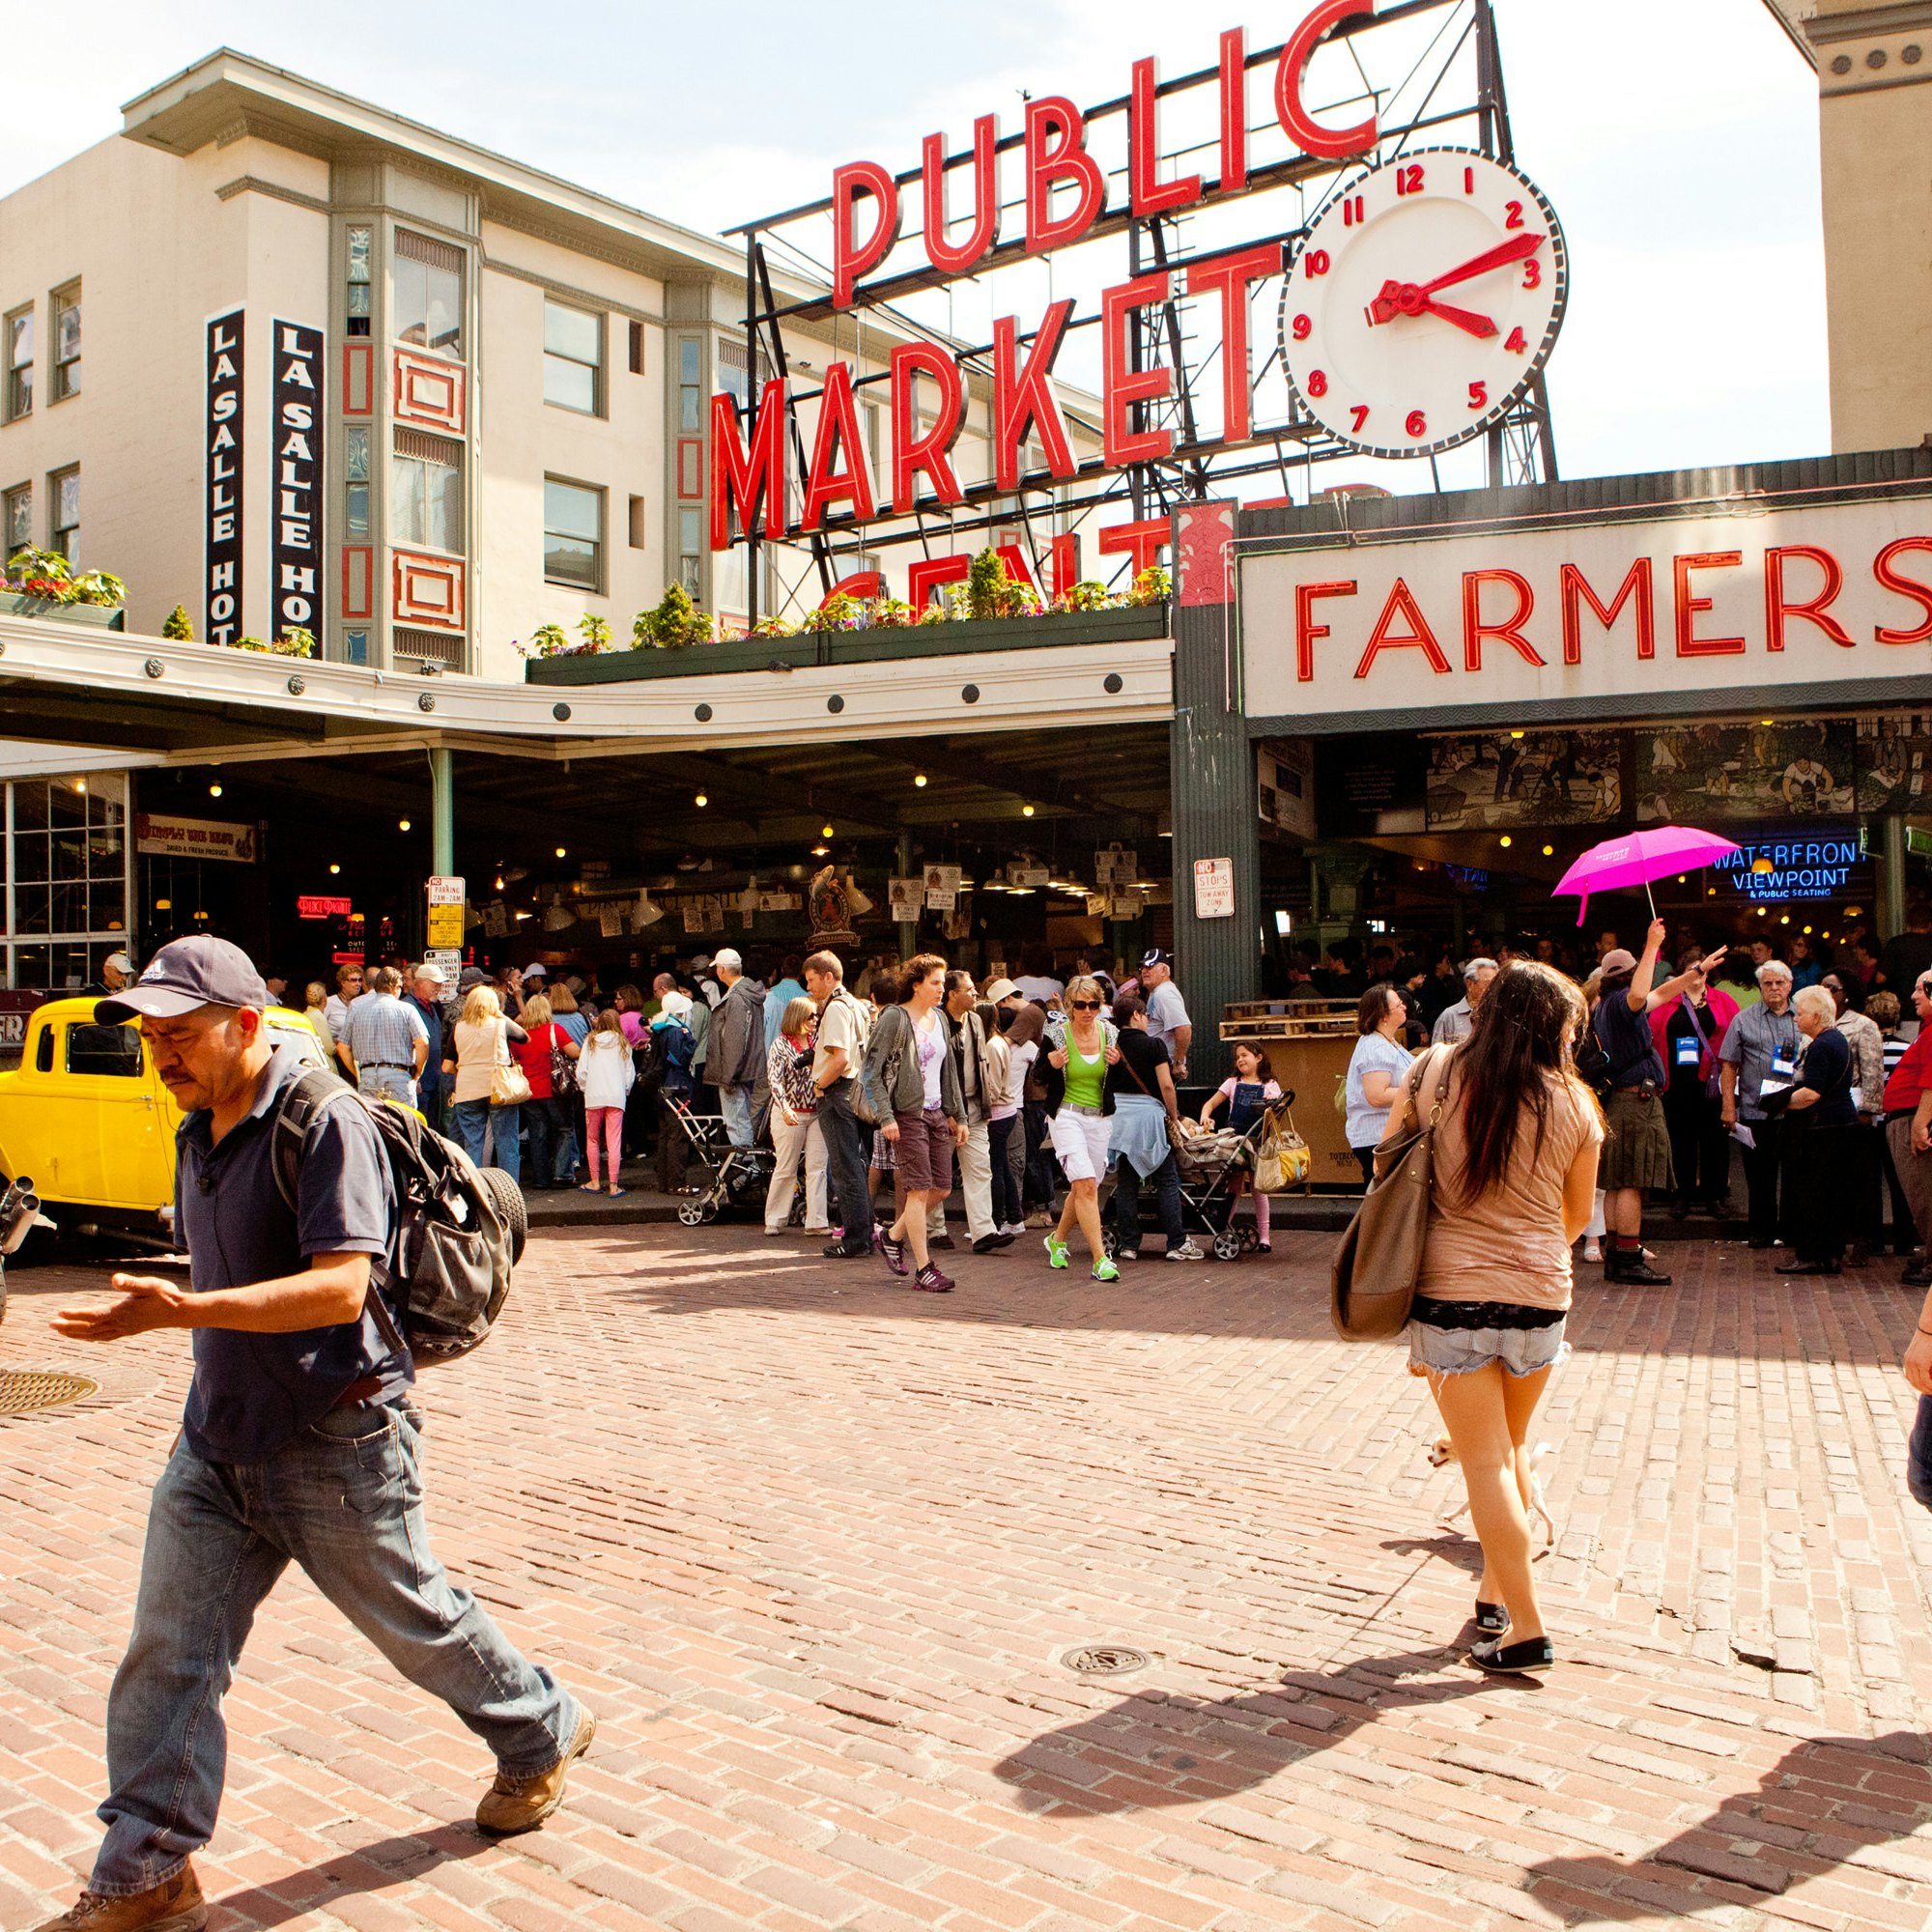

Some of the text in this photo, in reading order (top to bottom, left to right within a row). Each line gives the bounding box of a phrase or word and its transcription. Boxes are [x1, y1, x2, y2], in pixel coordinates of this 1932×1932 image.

[833, 0, 1379, 309] PUBLIC
[1396, 164, 1425, 197] 12
[1463, 166, 1474, 195] 1
[1343, 196, 1365, 227] 11
[1504, 200, 1525, 231] 2
[1304, 249, 1331, 280] 10
[1521, 259, 1543, 290] 3
[1292, 313, 1313, 341] 9
[1503, 326, 1528, 355] 4
[213, 326, 238, 382] LA
[711, 242, 1285, 551] MARKET
[1306, 369, 1328, 398] 8
[1467, 381, 1489, 411] 5
[1350, 405, 1370, 433] 7
[1405, 410, 1427, 438] 6
[212, 391, 238, 544] SALLE
[280, 327, 315, 641] LA SALLE HO
[1294, 535, 1932, 682] FARMERS
[1198, 862, 1212, 874] NO
[1714, 842, 1866, 869] WATERFRON
[1199, 874, 1228, 887] STOPS
[1733, 867, 1850, 890] VIEWPOINT
[1749, 888, 1832, 898] & PUBLIC SEATING
